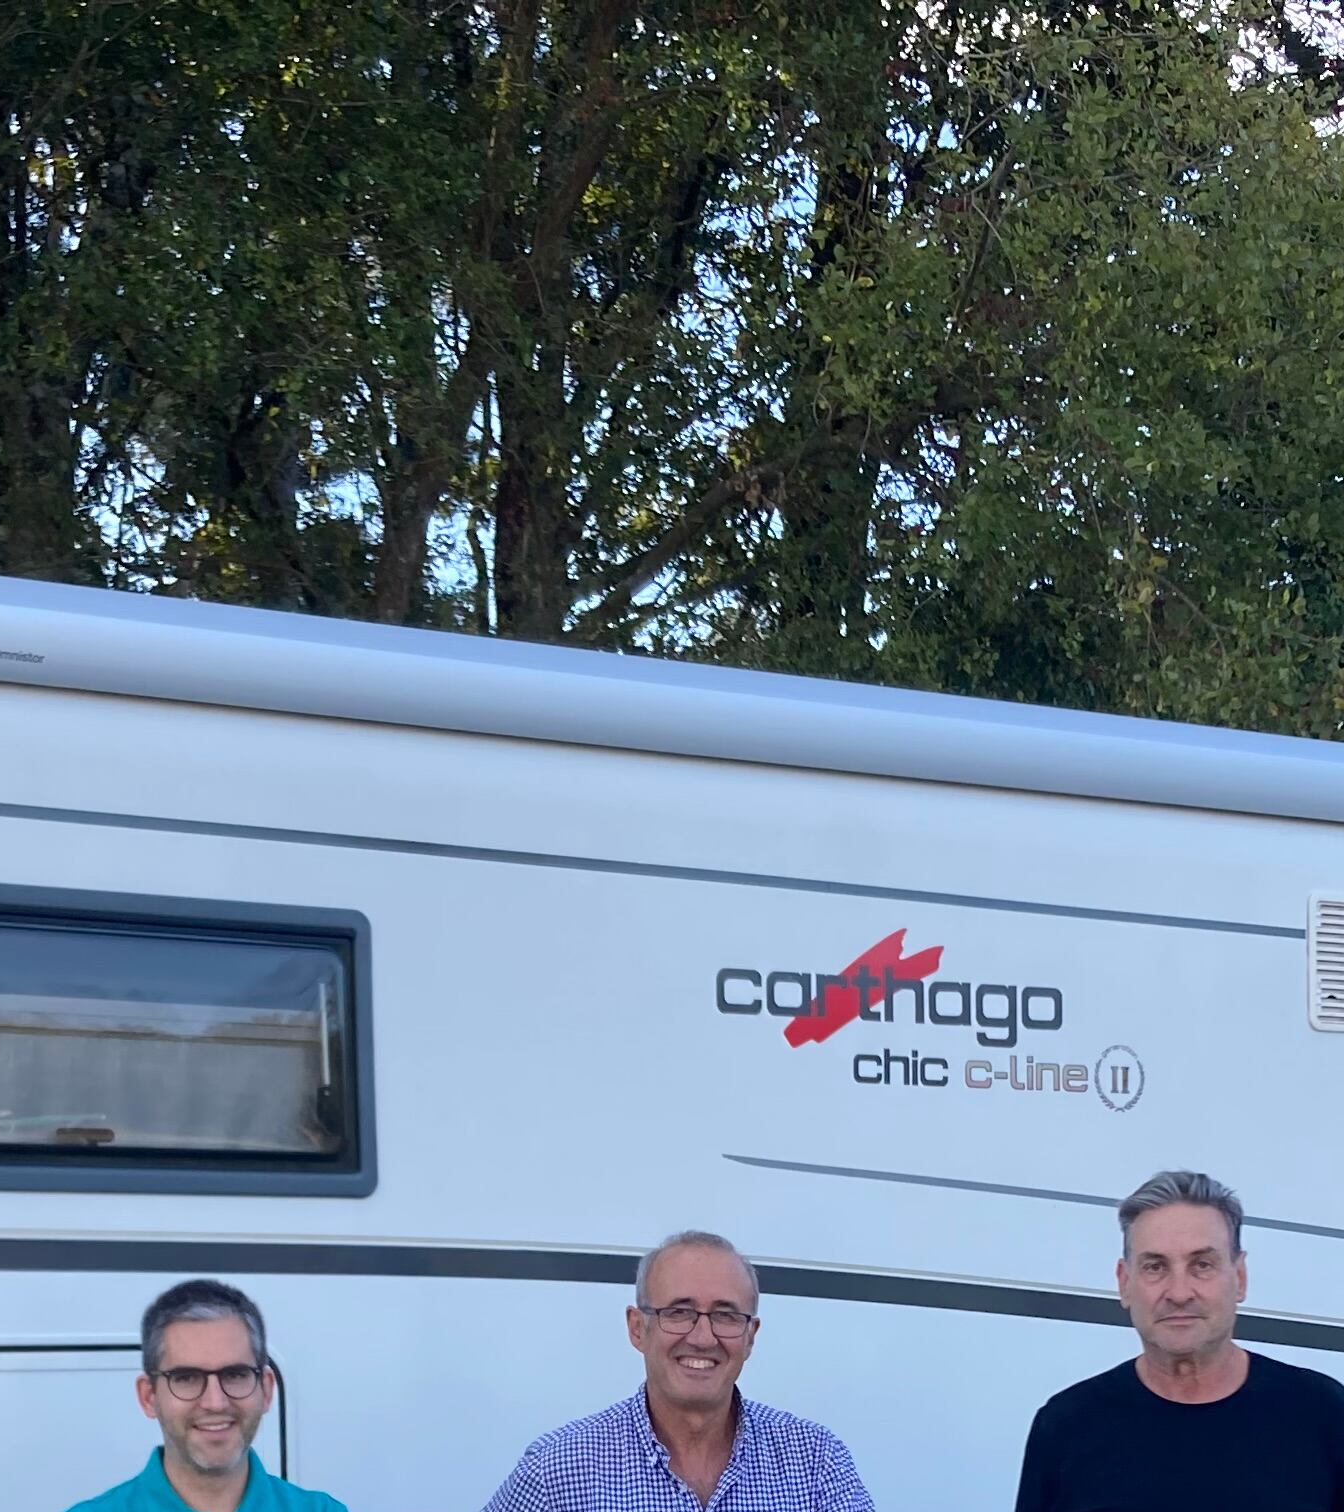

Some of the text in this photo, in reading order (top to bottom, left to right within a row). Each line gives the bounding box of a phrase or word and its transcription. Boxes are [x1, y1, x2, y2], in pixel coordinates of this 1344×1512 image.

[716, 966, 1063, 1048] carthago
[853, 1048, 948, 1087] chic
[964, 1054, 1089, 1093] c-line
